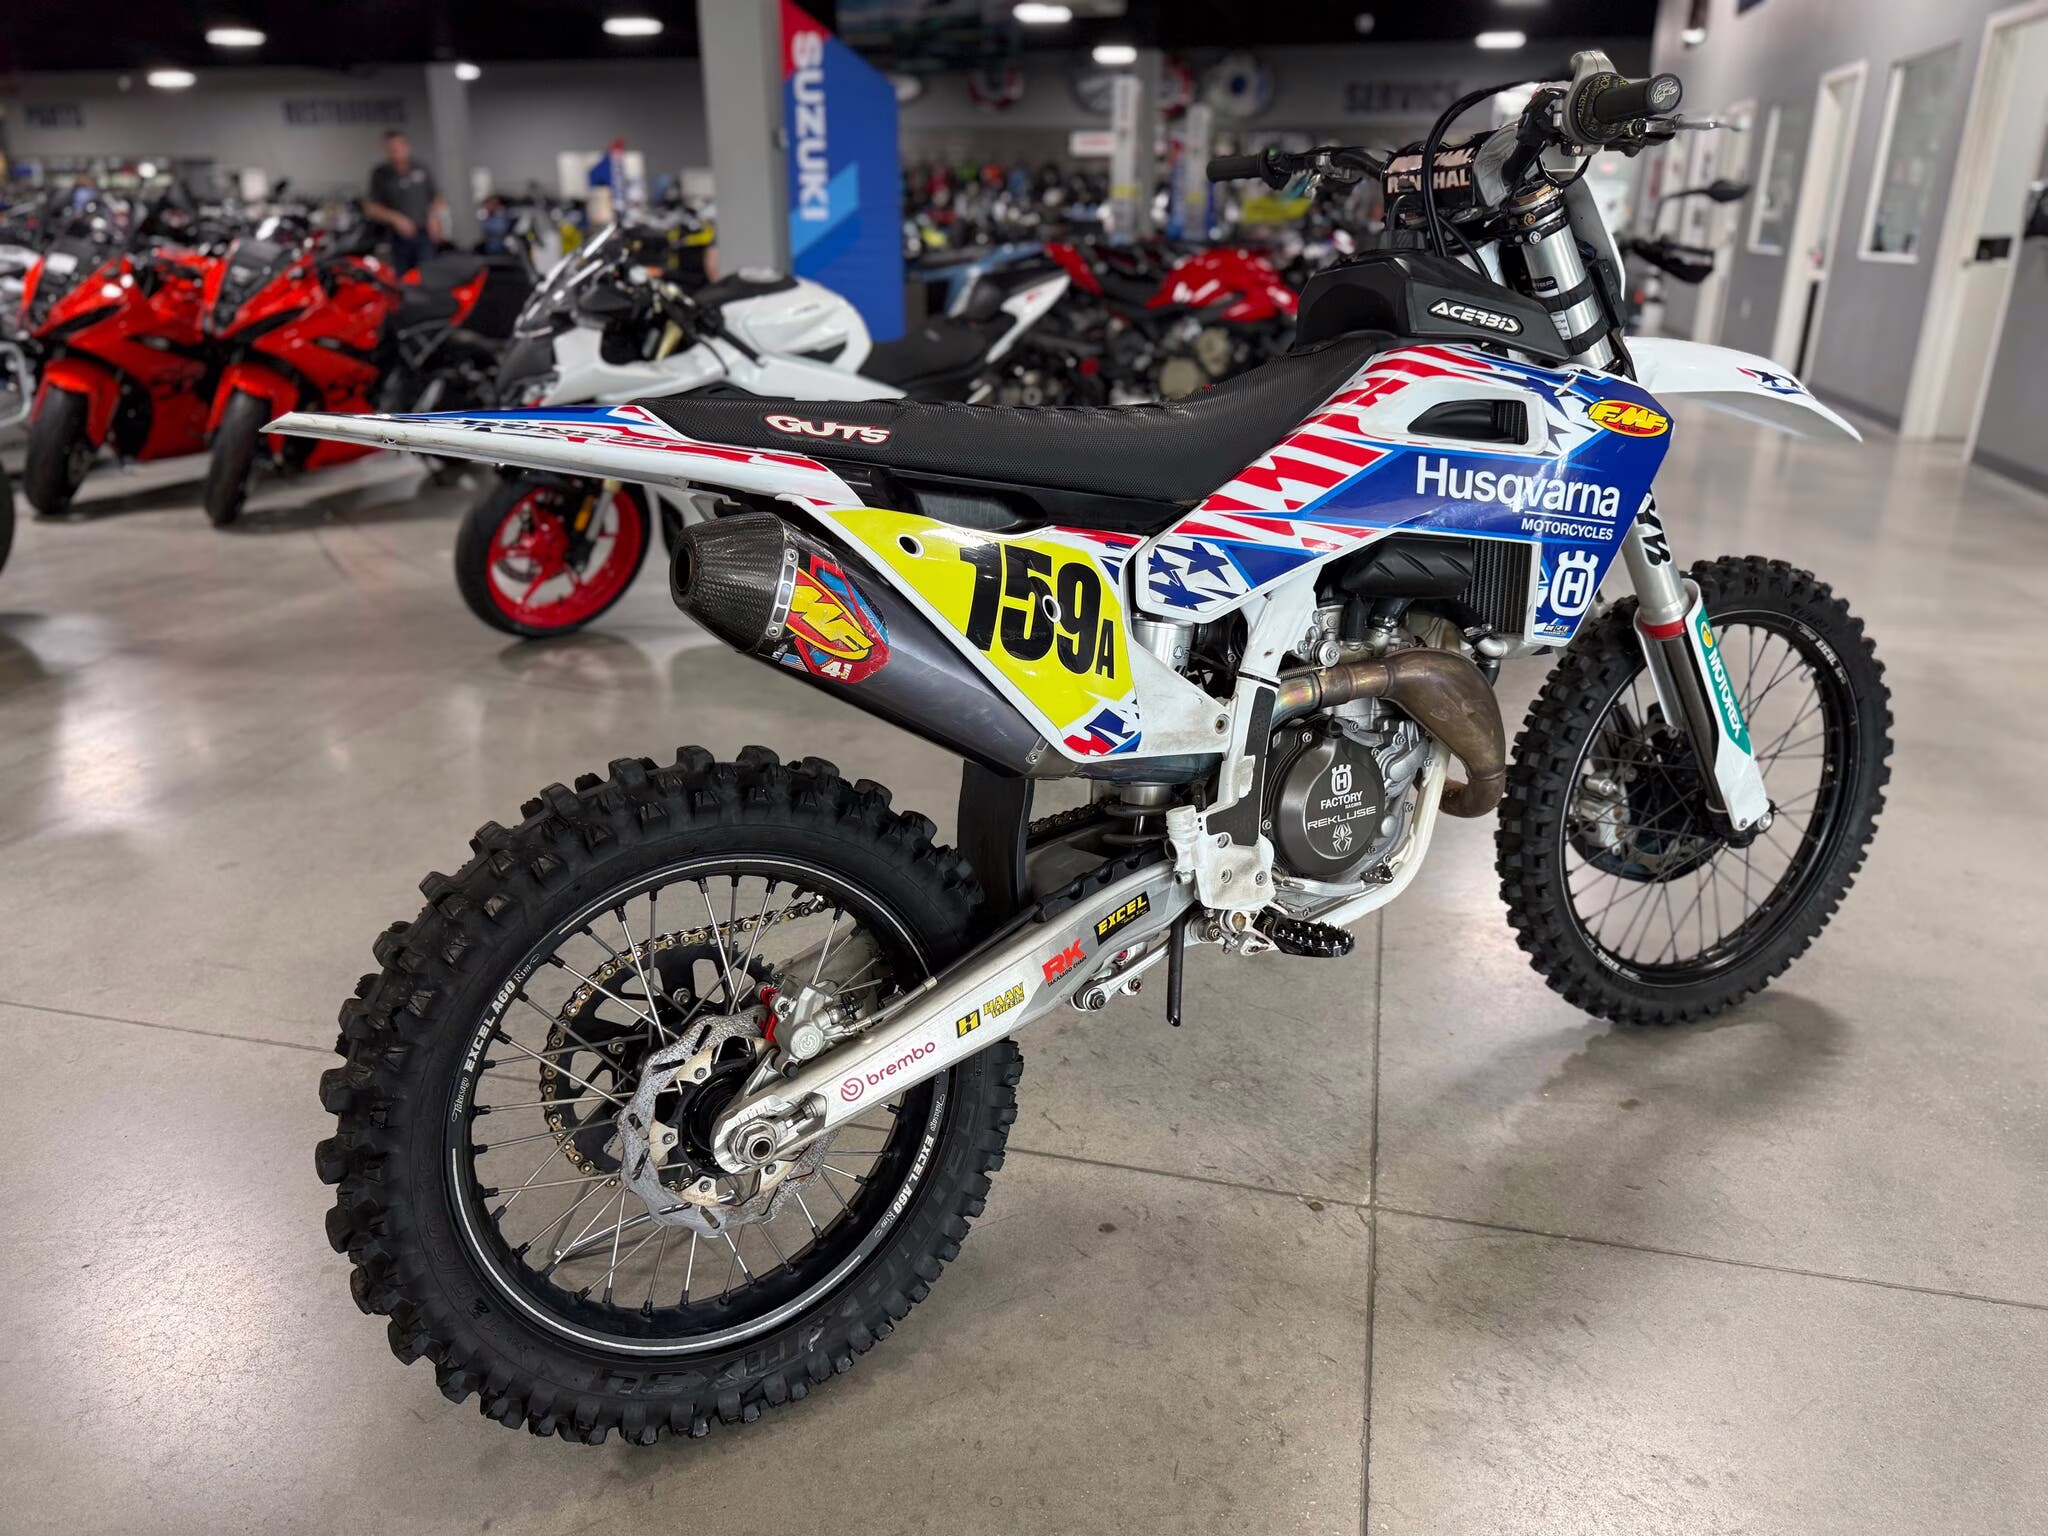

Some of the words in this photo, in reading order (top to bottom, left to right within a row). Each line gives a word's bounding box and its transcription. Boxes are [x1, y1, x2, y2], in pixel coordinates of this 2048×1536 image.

[791, 31, 829, 221] SUZUKI
[1387, 168, 1471, 194] RNHAL
[765, 414, 890, 444] GUTS
[1589, 403, 1668, 431] FMF
[1416, 455, 1620, 518] Husqvarna
[1521, 518, 1614, 540] MOTORCYCLES
[1637, 493, 1672, 567] YB
[1708, 648, 1742, 739] MOTOREX
[1307, 805, 1377, 831] REKLUSE
[1320, 790, 1363, 810] FACTORY
[1098, 896, 1148, 936] EXCEL
[1041, 938, 1086, 984] RK
[464, 1015, 496, 1073] EXCEL
[491, 980, 516, 1015] A60
[513, 961, 533, 983] Rim
[984, 982, 1024, 1016] HAAN
[867, 1042, 936, 1086] brembo
[908, 1134, 935, 1182] EXCEL
[893, 1183, 913, 1215] A60
